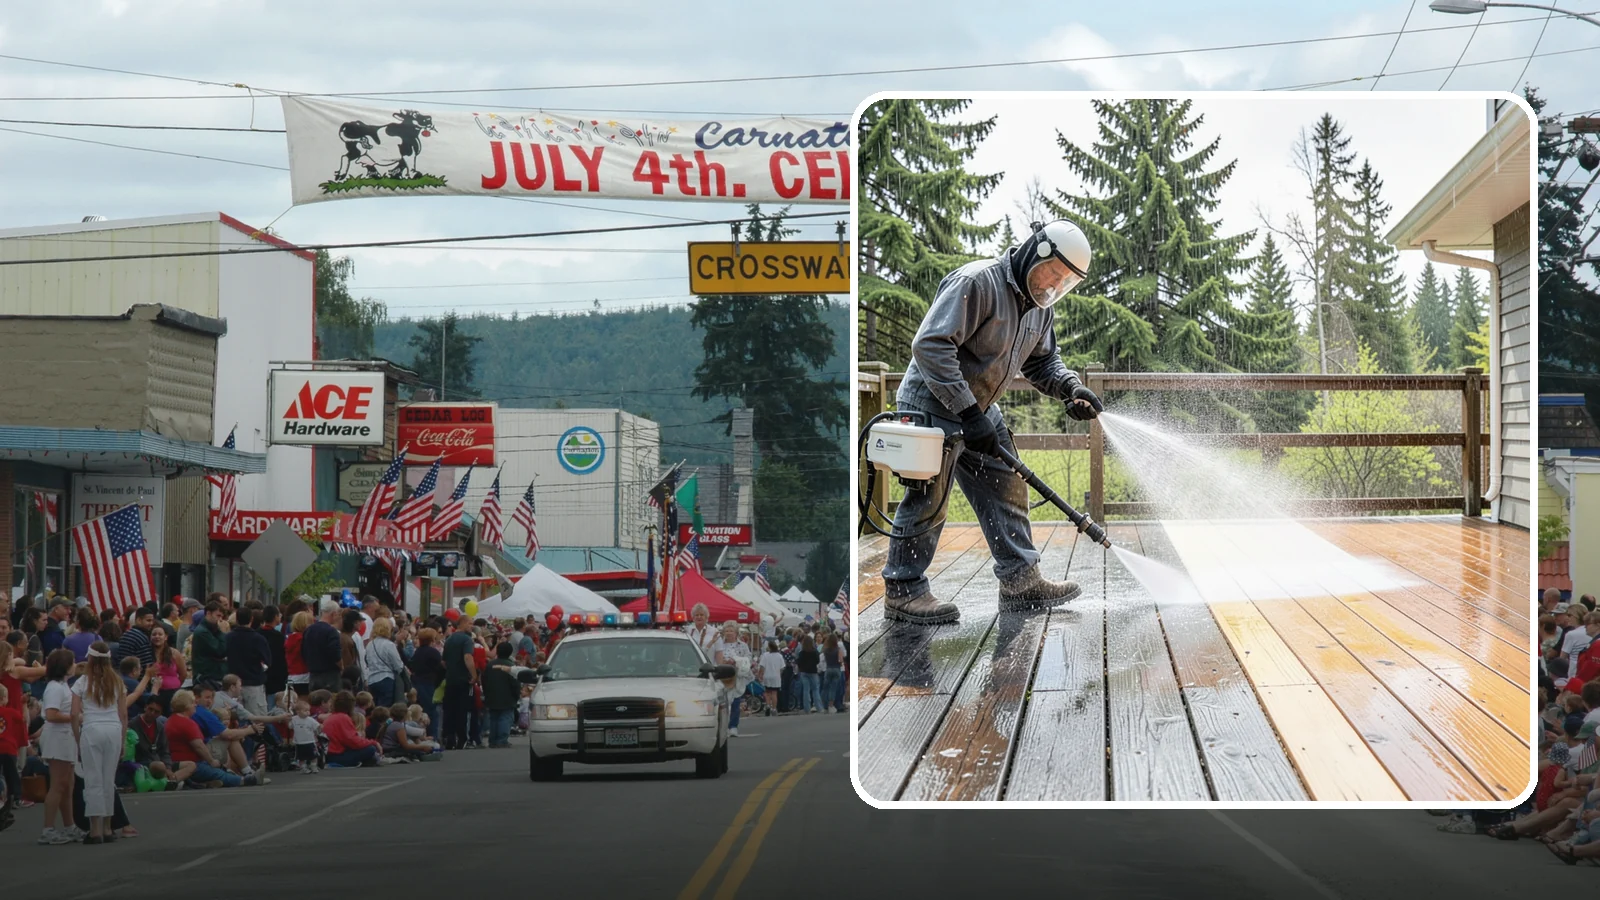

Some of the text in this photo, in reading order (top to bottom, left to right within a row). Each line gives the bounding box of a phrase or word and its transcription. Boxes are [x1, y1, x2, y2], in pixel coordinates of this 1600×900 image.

[481, 141, 605, 192] JULY
[632, 150, 746, 198] 4th.
[696, 254, 850, 281] CROSSWA
[282, 379, 374, 420] ACE
[405, 409, 485, 422] CEDAR LOG
[283, 421, 371, 436] Hardware
[416, 428, 477, 447] Coca-Cola
[95, 485, 124, 495] Vincent
[126, 485, 136, 495] de
[137, 486, 155, 495] Paul
[81, 503, 154, 522] THT
[212, 516, 331, 535] HARDARE
[688, 526, 741, 535] CRNATION
[699, 535, 730, 543] GLASS
